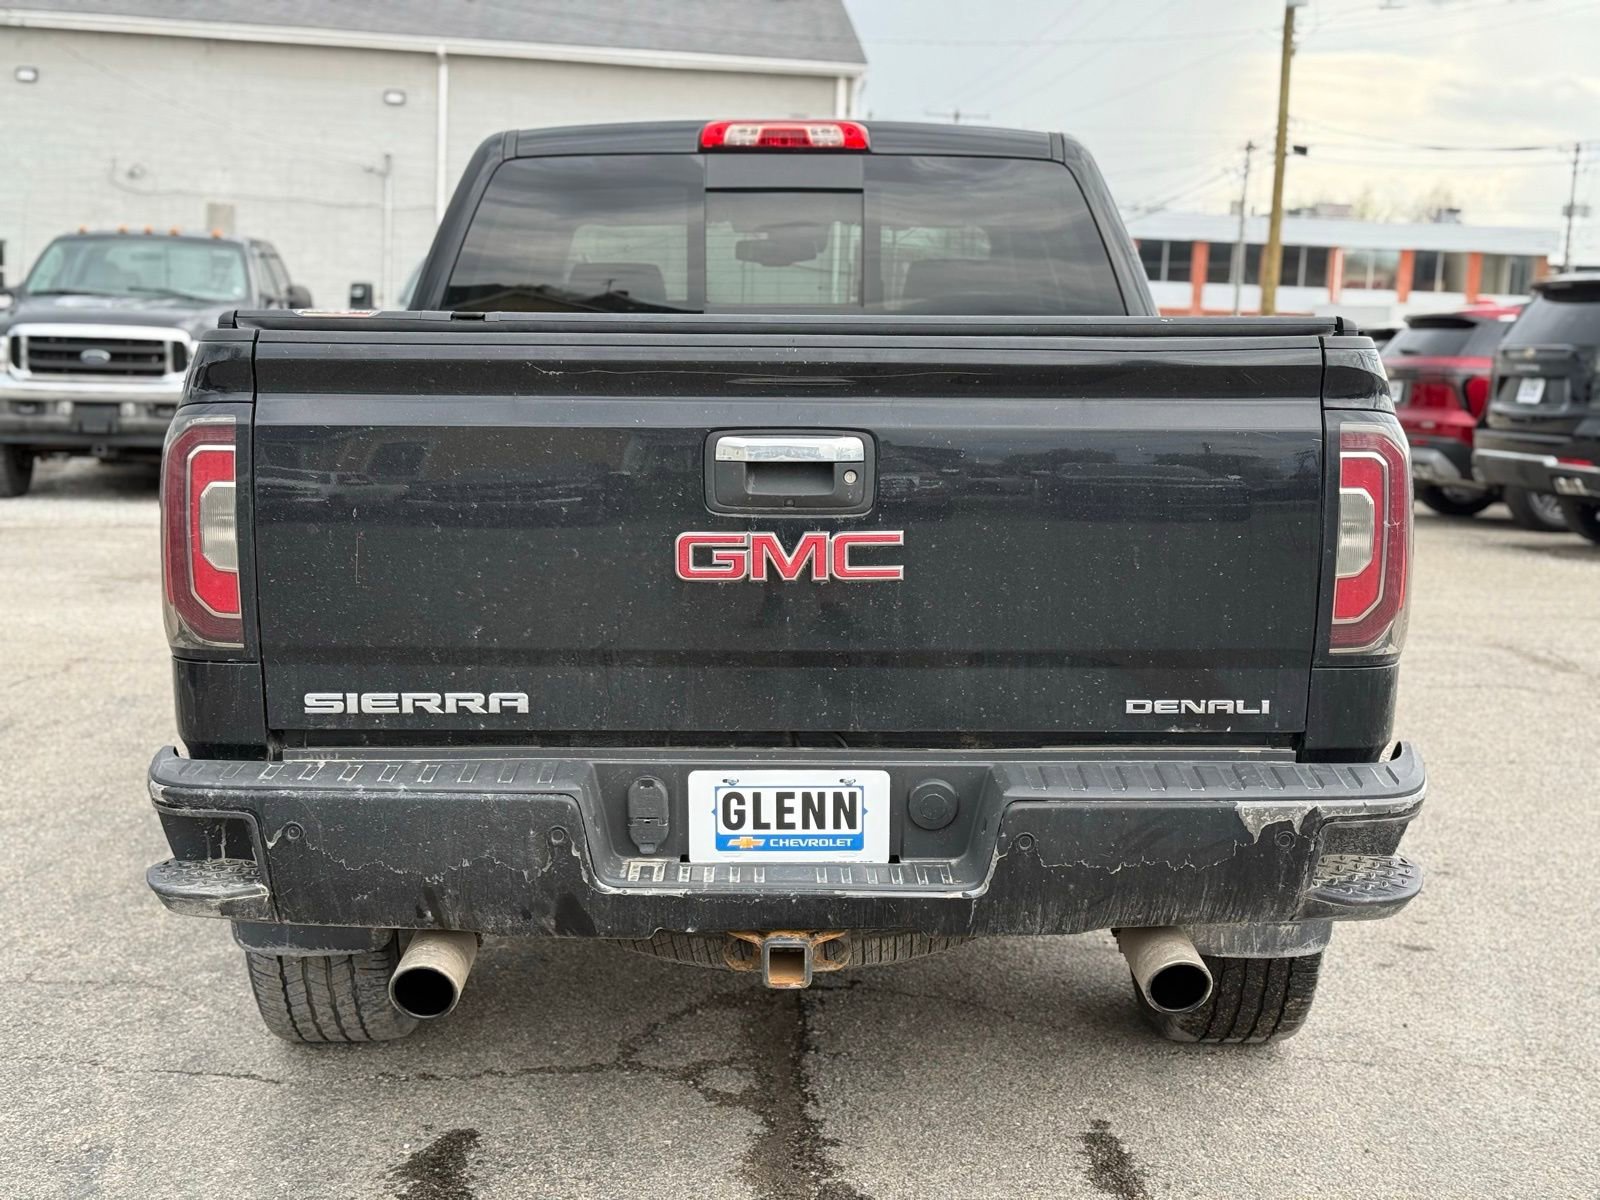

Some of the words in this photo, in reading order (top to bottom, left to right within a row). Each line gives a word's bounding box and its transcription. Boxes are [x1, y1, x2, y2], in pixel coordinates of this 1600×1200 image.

[675, 530, 904, 582] GMC
[303, 692, 529, 714] SIERRA
[1125, 699, 1270, 715] DENALI
[722, 791, 857, 831] GLENN
[769, 838, 853, 847] CHEVROLET
